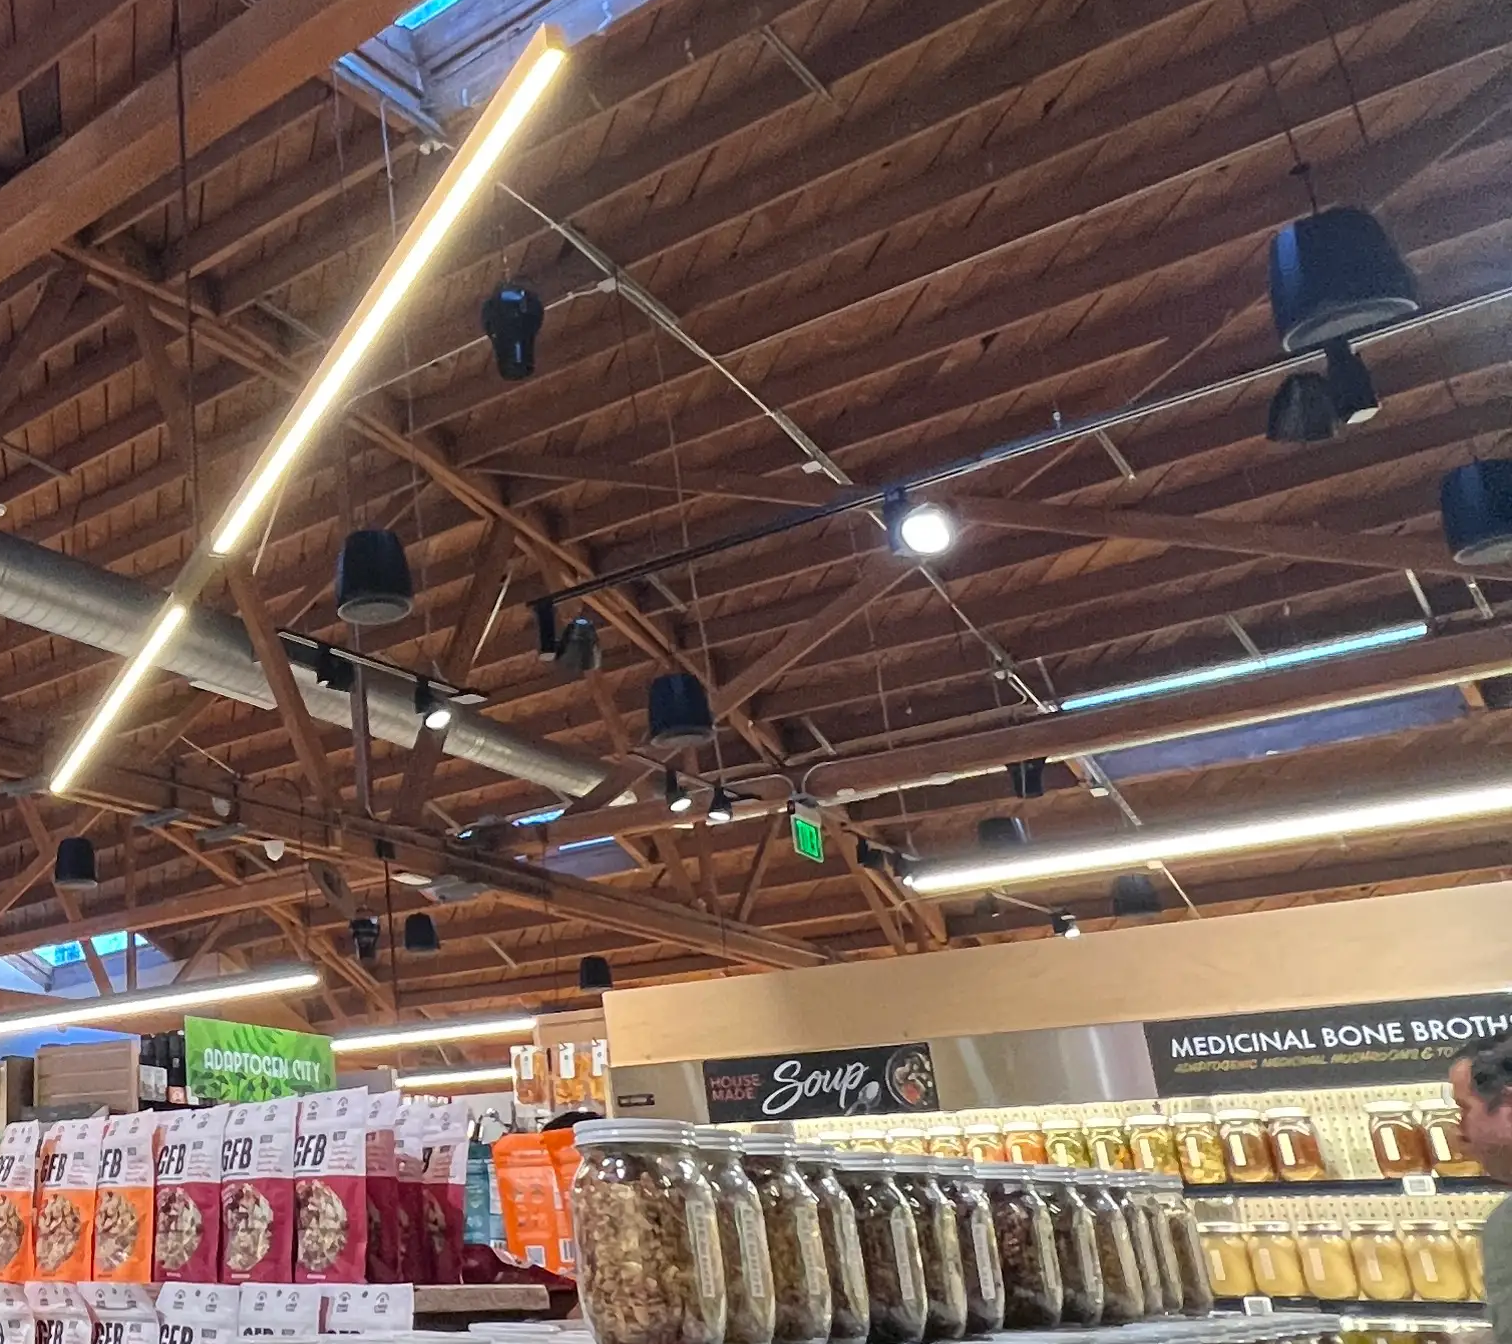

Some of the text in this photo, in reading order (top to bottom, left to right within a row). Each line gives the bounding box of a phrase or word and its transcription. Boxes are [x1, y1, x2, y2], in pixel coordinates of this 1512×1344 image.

[1170, 1014, 1512, 1058] MEDICINAL BONE BROTH
[203, 1047, 321, 1084] ADAPTOGEN CITY
[709, 1073, 763, 1088] HOUSE
[712, 1087, 757, 1102] MADE
[761, 1060, 870, 1116] Soup
[157, 1143, 187, 1175] GFB
[221, 1137, 253, 1170] GFB
[293, 1133, 328, 1167] GFB
[40, 1153, 67, 1182] GFB
